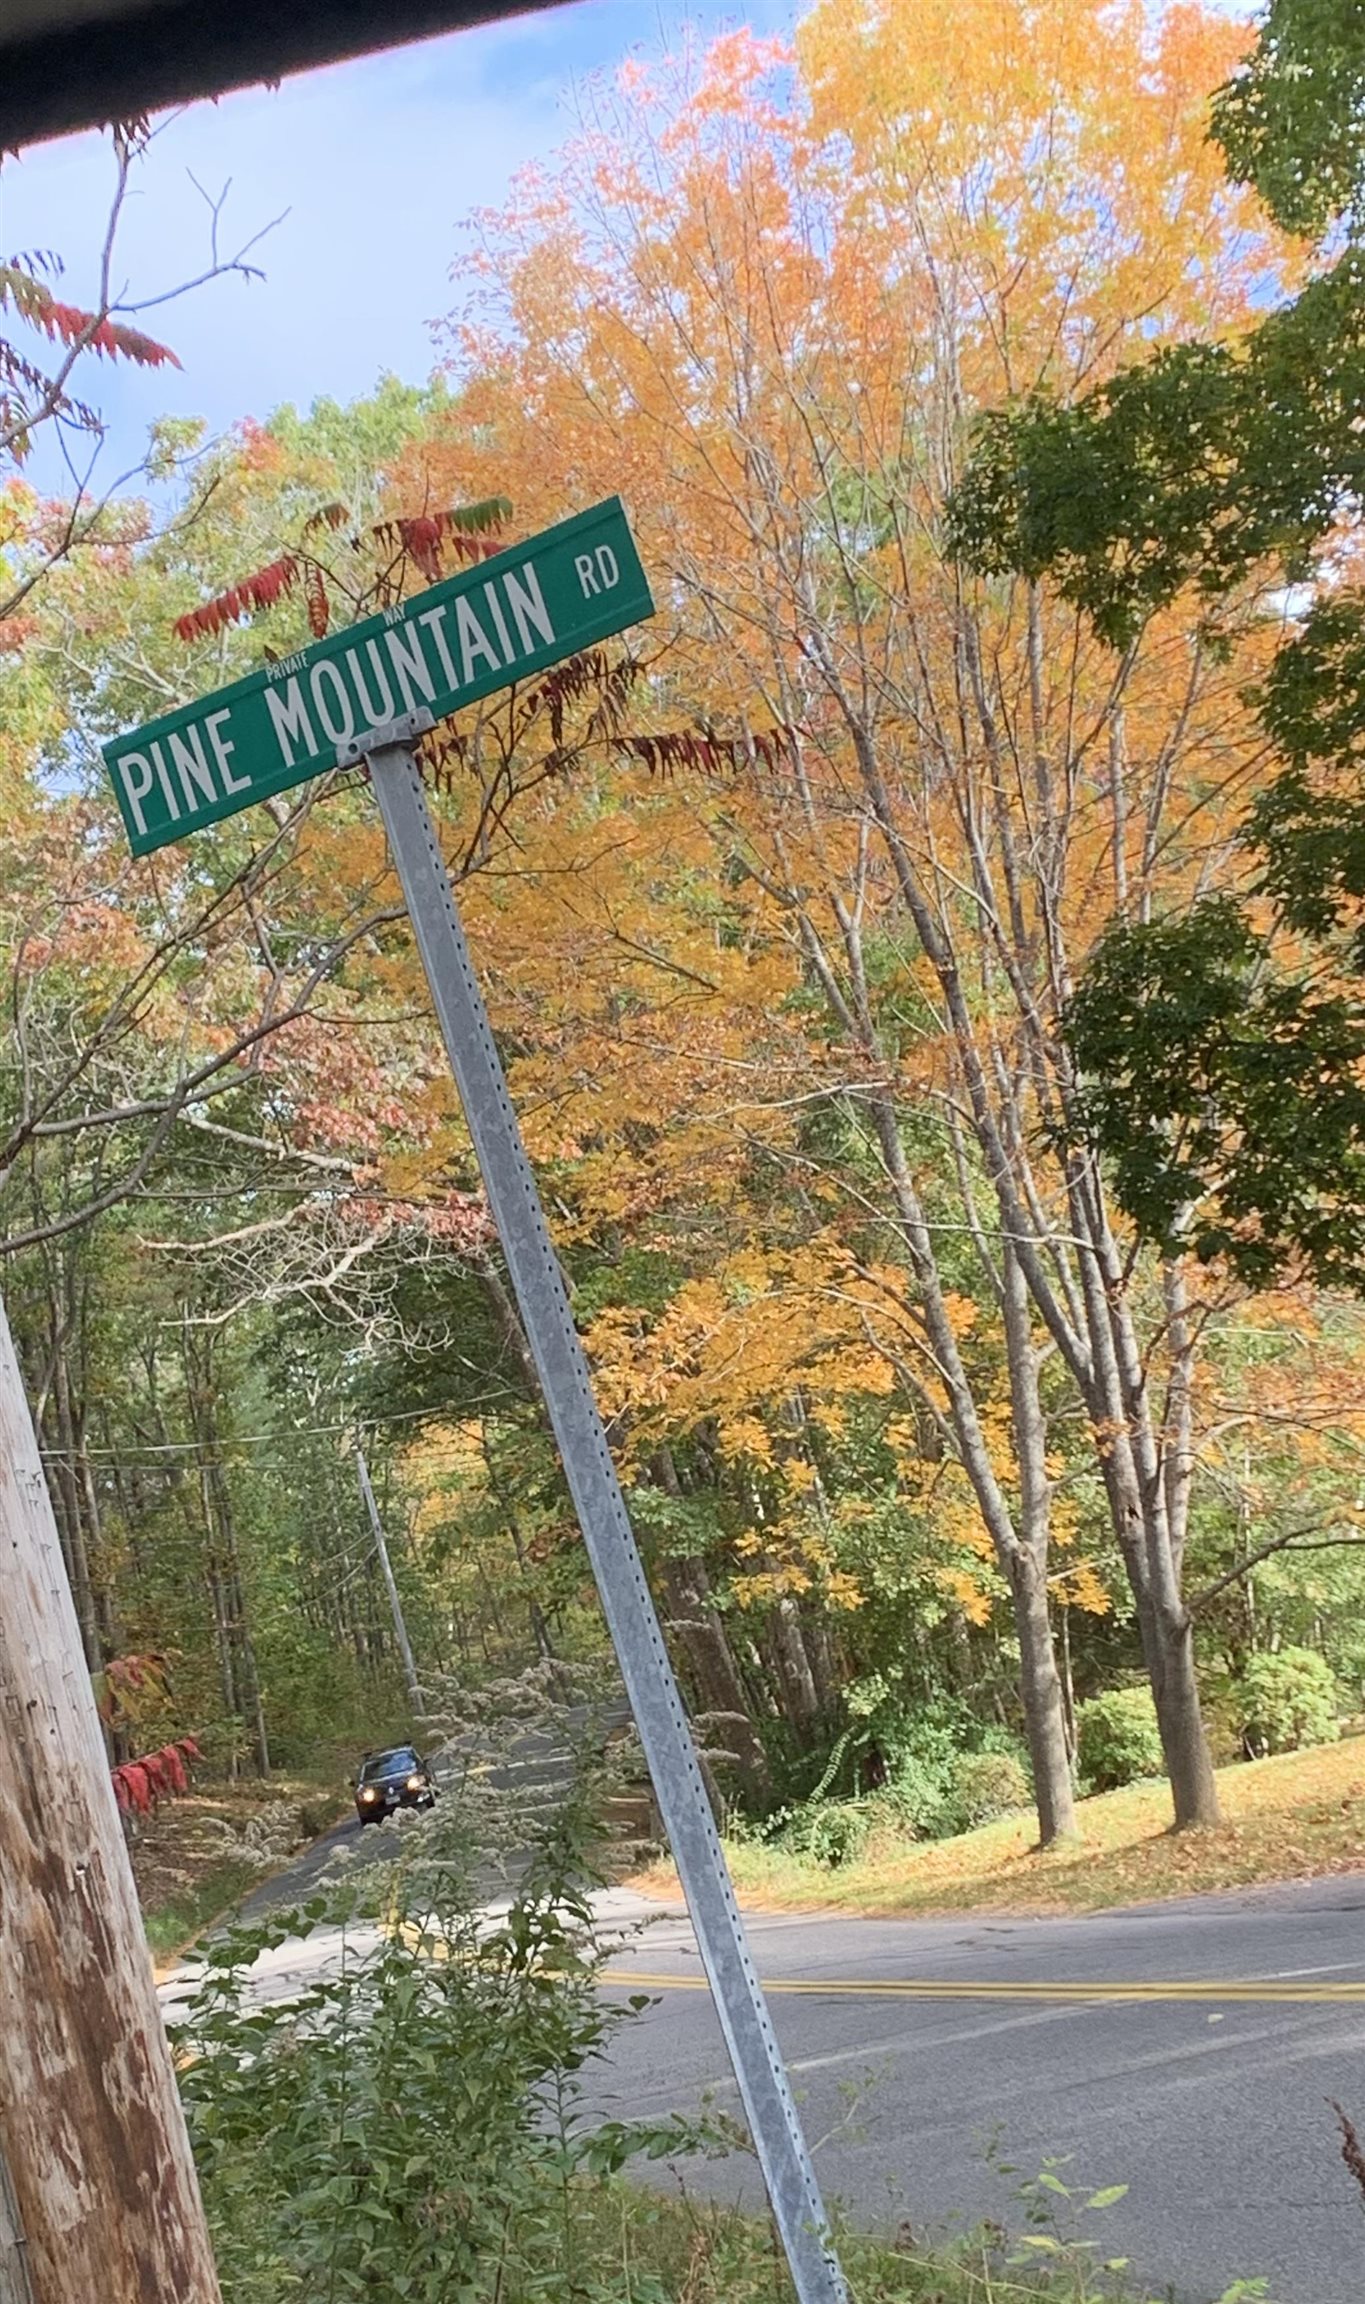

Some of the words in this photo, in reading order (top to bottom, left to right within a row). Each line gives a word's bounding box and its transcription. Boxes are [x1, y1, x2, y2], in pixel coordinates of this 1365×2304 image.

[117, 708, 252, 835] PINE
[264, 562, 555, 768] MOUNTAIN
[574, 545, 619, 598] RD
[266, 651, 309, 682] PRIVATE
[383, 603, 406, 626] WAY
